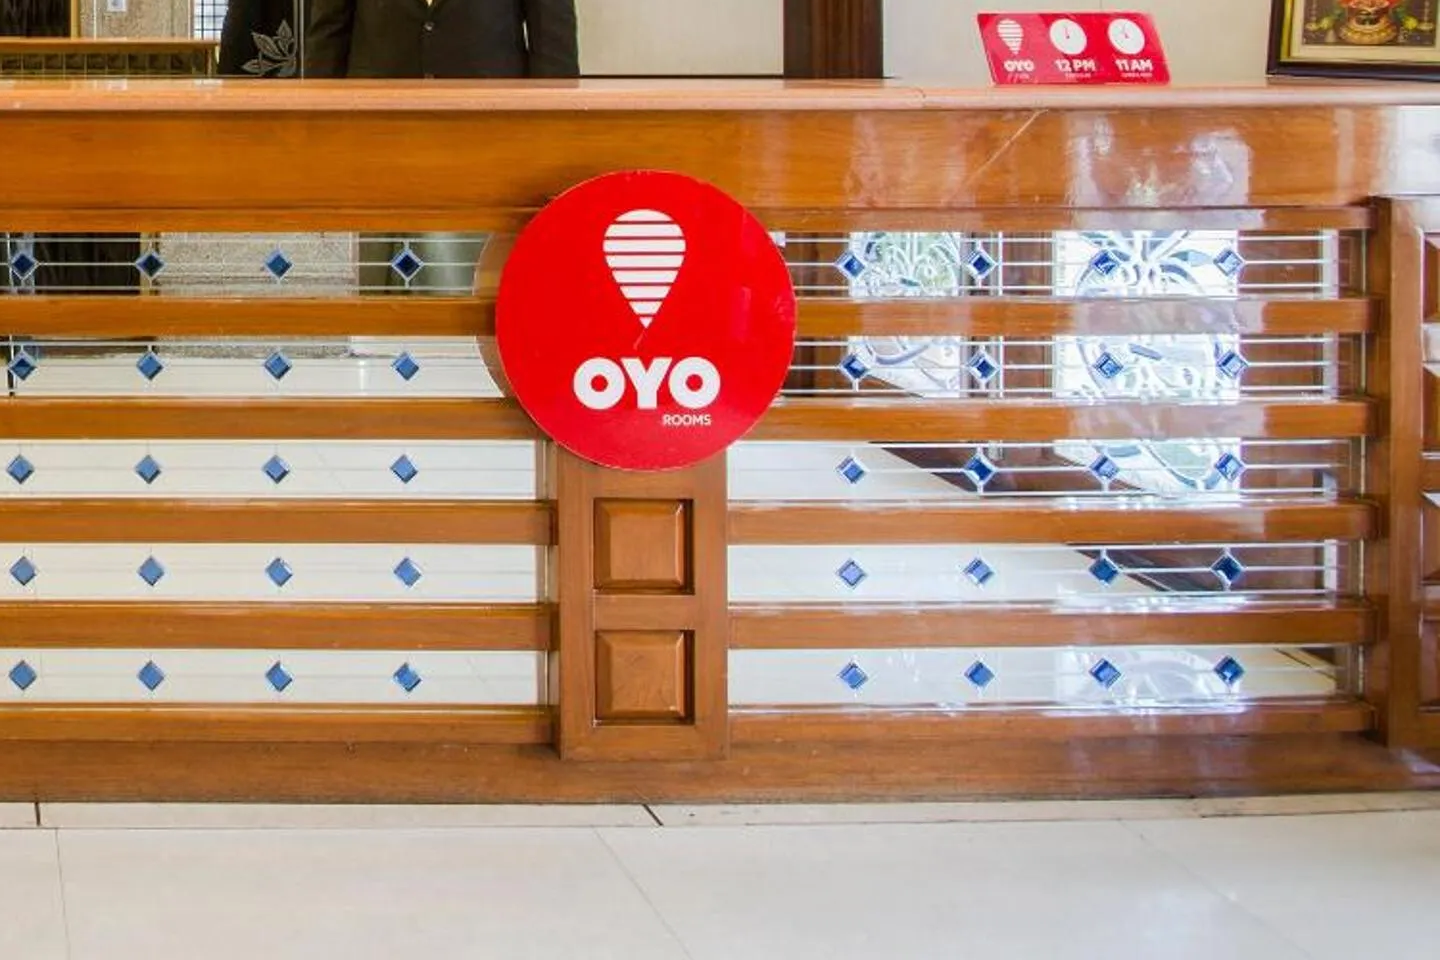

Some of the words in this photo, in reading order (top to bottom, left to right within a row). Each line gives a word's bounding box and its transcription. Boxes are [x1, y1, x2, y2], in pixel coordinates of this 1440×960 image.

[1004, 59, 1035, 72] OYO
[1055, 59, 1072, 72] 12
[1073, 59, 1096, 71] PM
[1115, 59, 1130, 71] 11
[1131, 59, 1153, 71] AM
[573, 357, 721, 410] OYO
[662, 414, 711, 426] ROOMS
